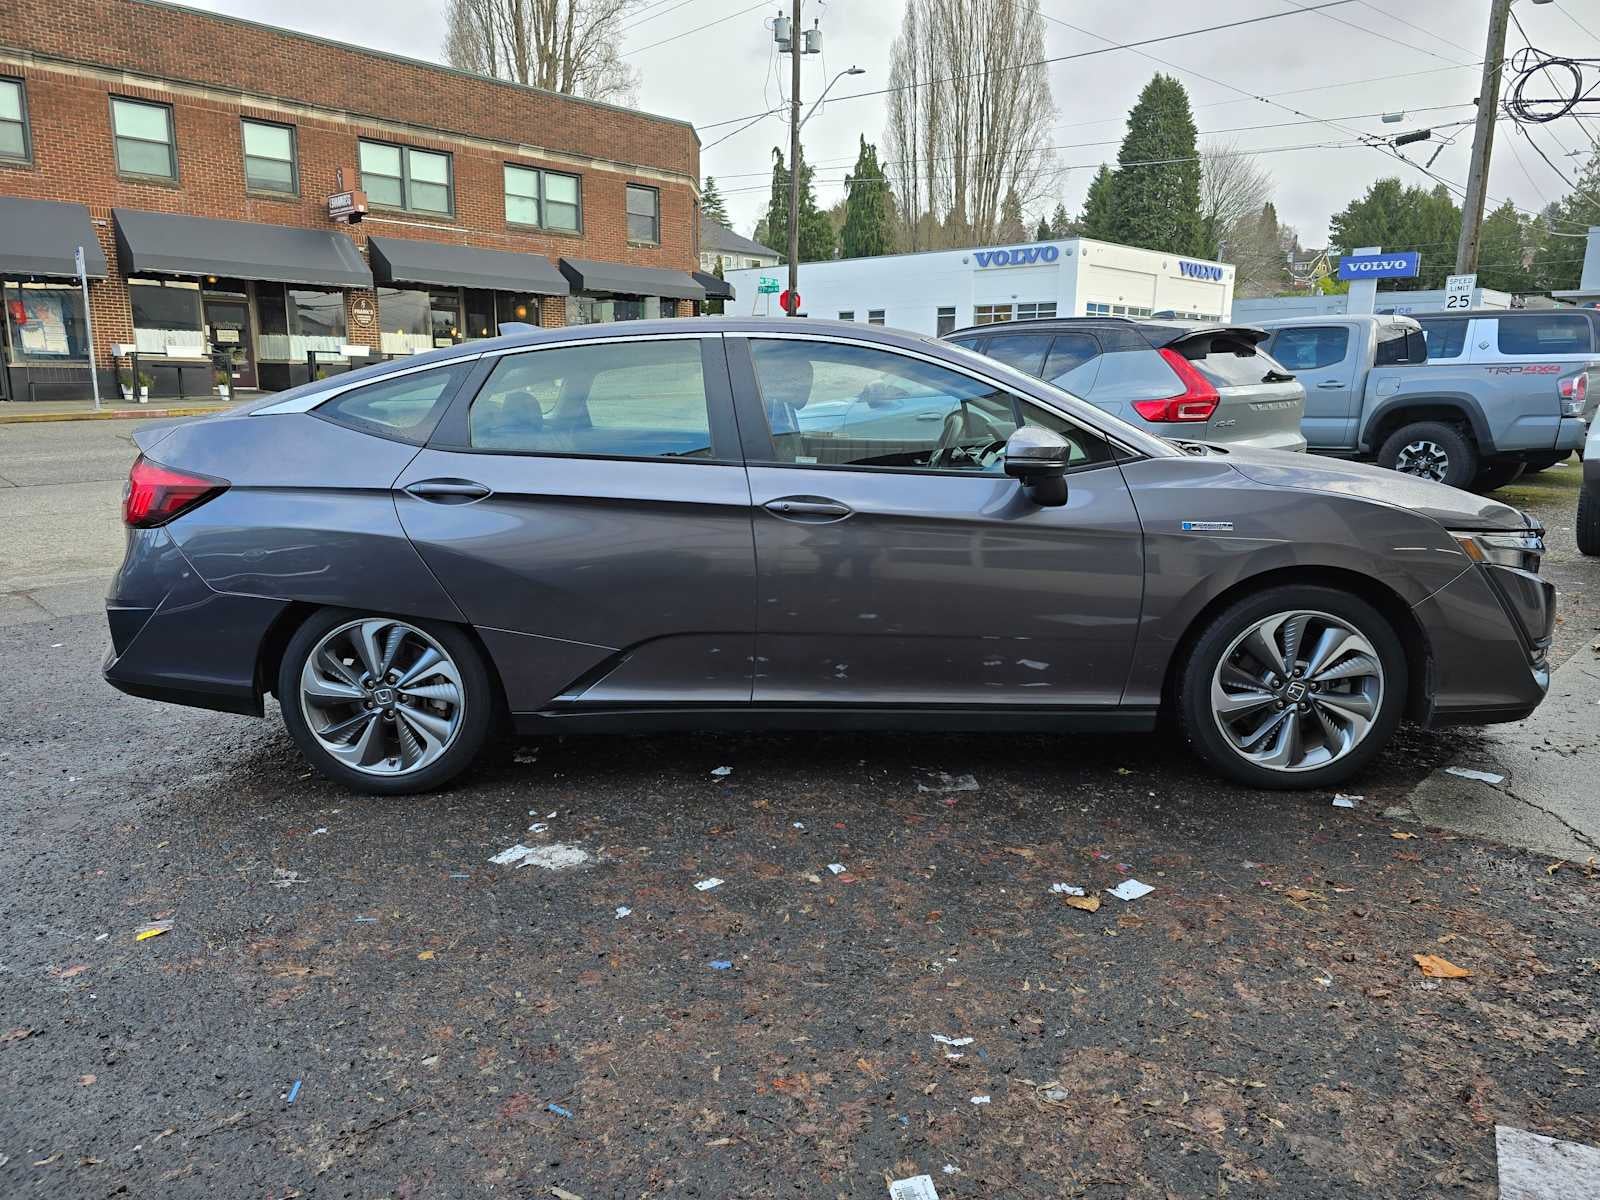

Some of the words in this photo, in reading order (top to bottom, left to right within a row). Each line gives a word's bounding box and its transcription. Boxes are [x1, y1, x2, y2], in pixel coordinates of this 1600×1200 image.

[973, 245, 1059, 267] VOLVO
[1179, 261, 1224, 281] VOLVO
[1347, 260, 1407, 272] VOLVO
[1447, 295, 1470, 308] 25
